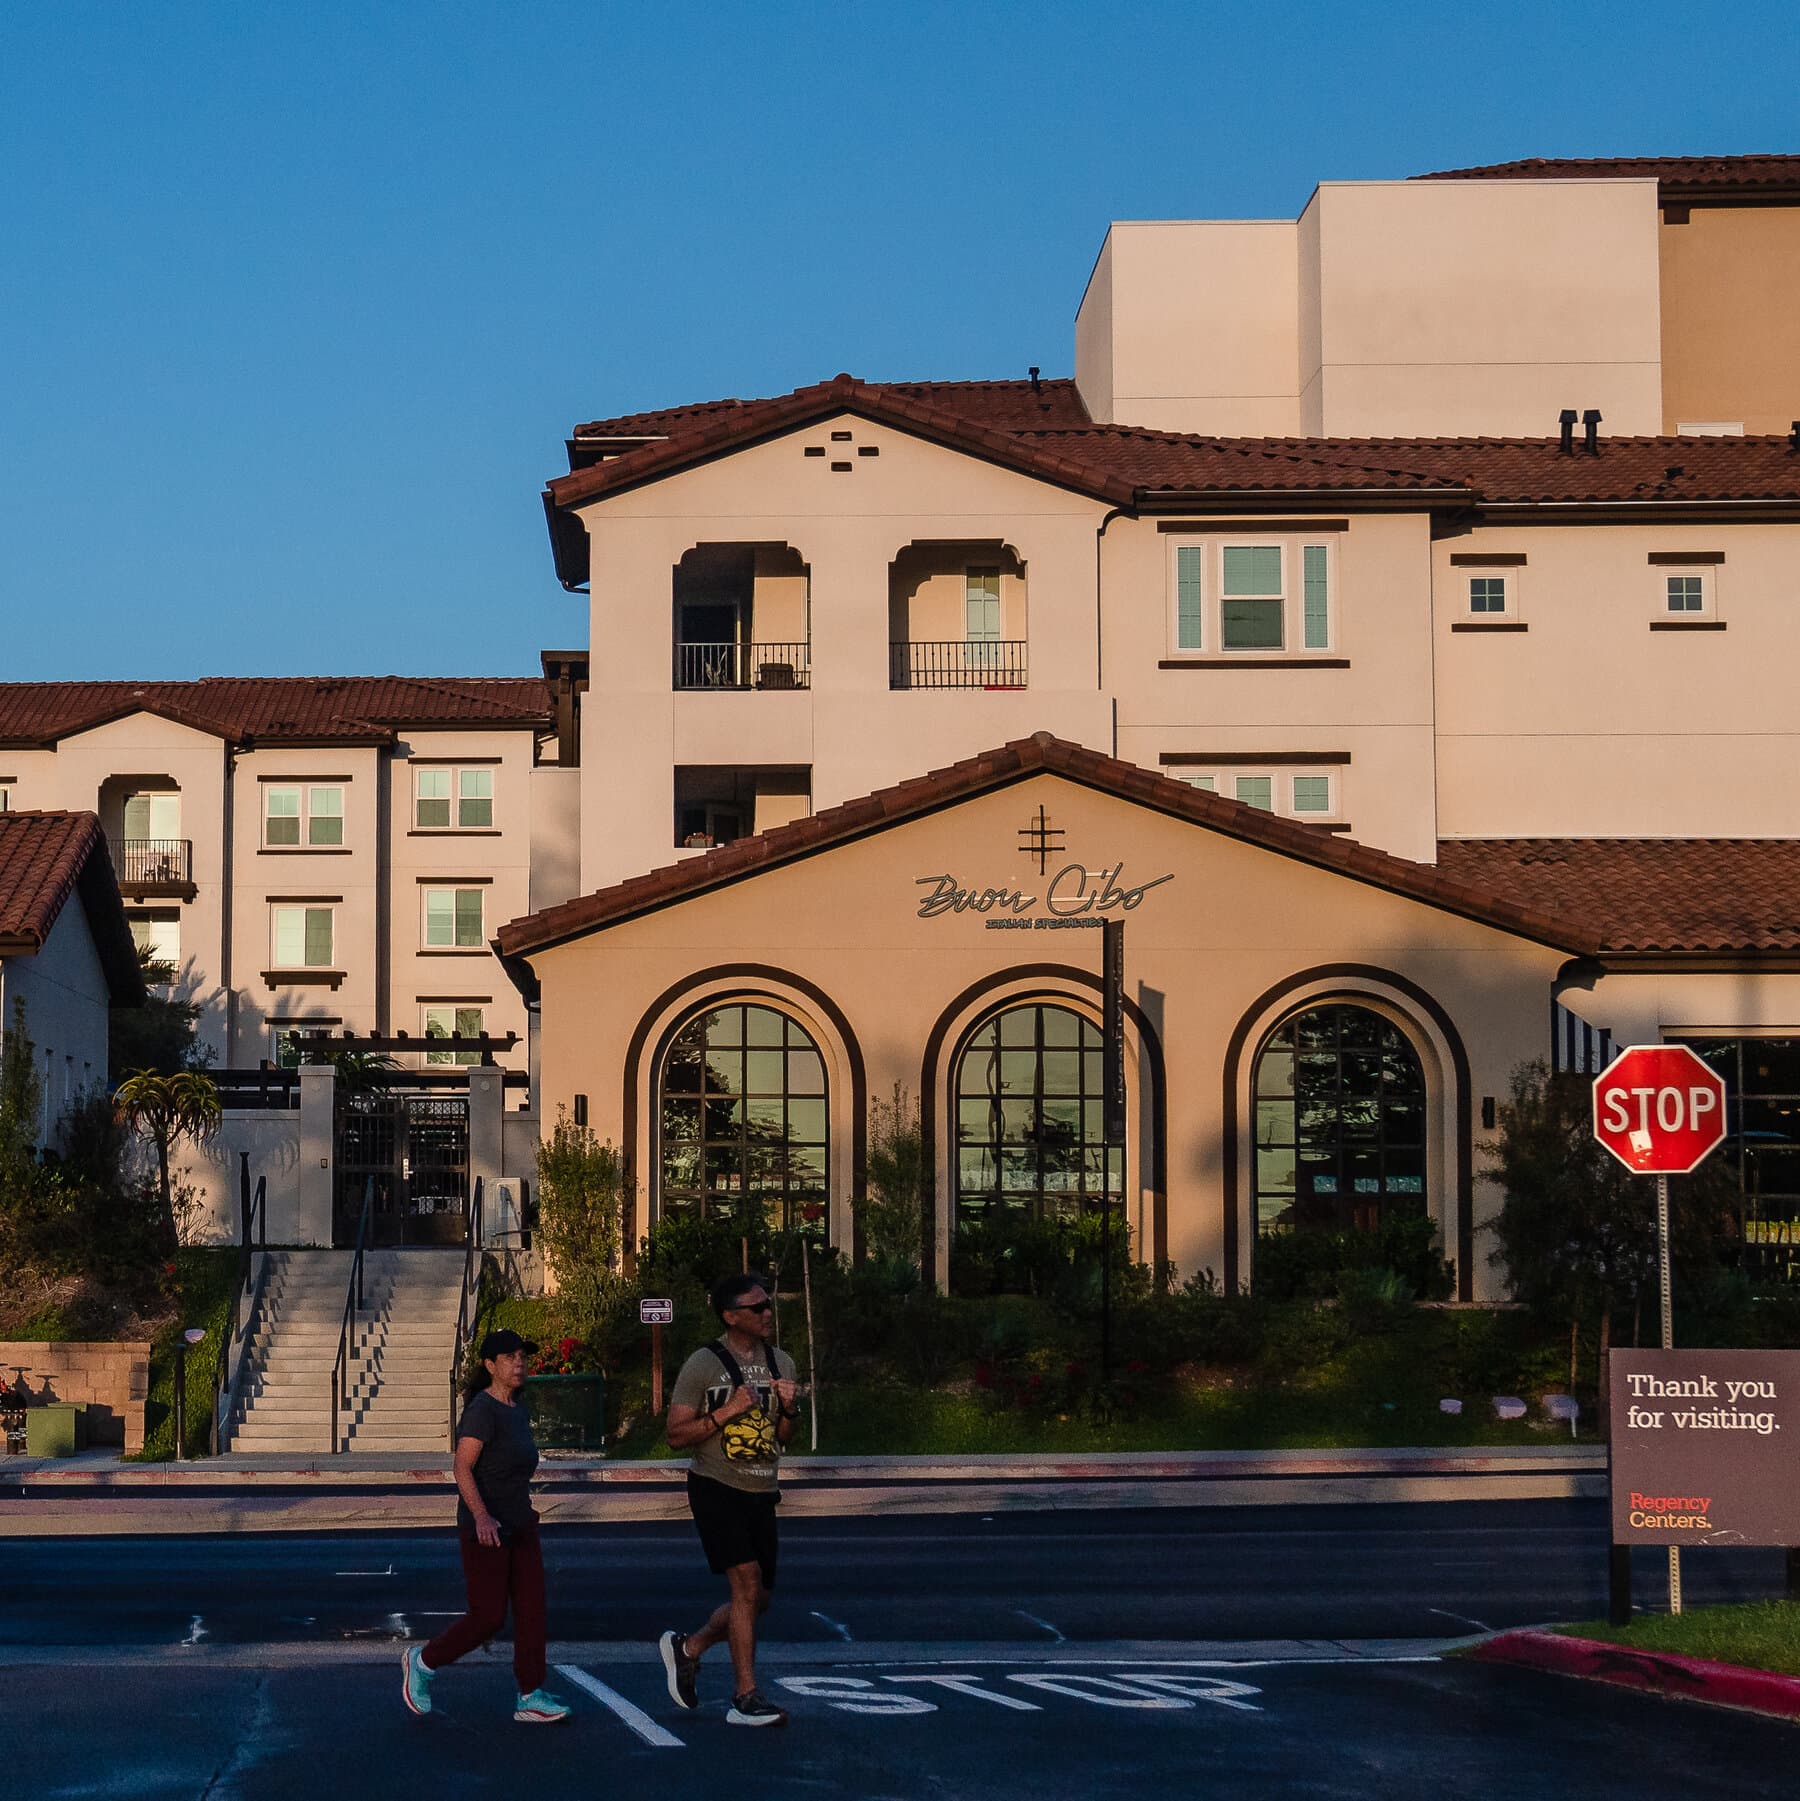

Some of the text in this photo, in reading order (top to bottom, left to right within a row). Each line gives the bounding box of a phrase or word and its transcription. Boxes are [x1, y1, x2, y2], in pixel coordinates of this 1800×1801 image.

[916, 862, 1174, 918] Buon Cibo
[985, 916, 1104, 930] ITALIAN SPECIALTIES
[1602, 1086, 1717, 1133] STOP
[1627, 1374, 1777, 1403] Thank you
[1627, 1406, 1781, 1435] for visiting.
[1629, 1492, 1712, 1513] Regency
[1629, 1512, 1713, 1529] Centers.
[774, 1673, 1265, 1715] STOP
